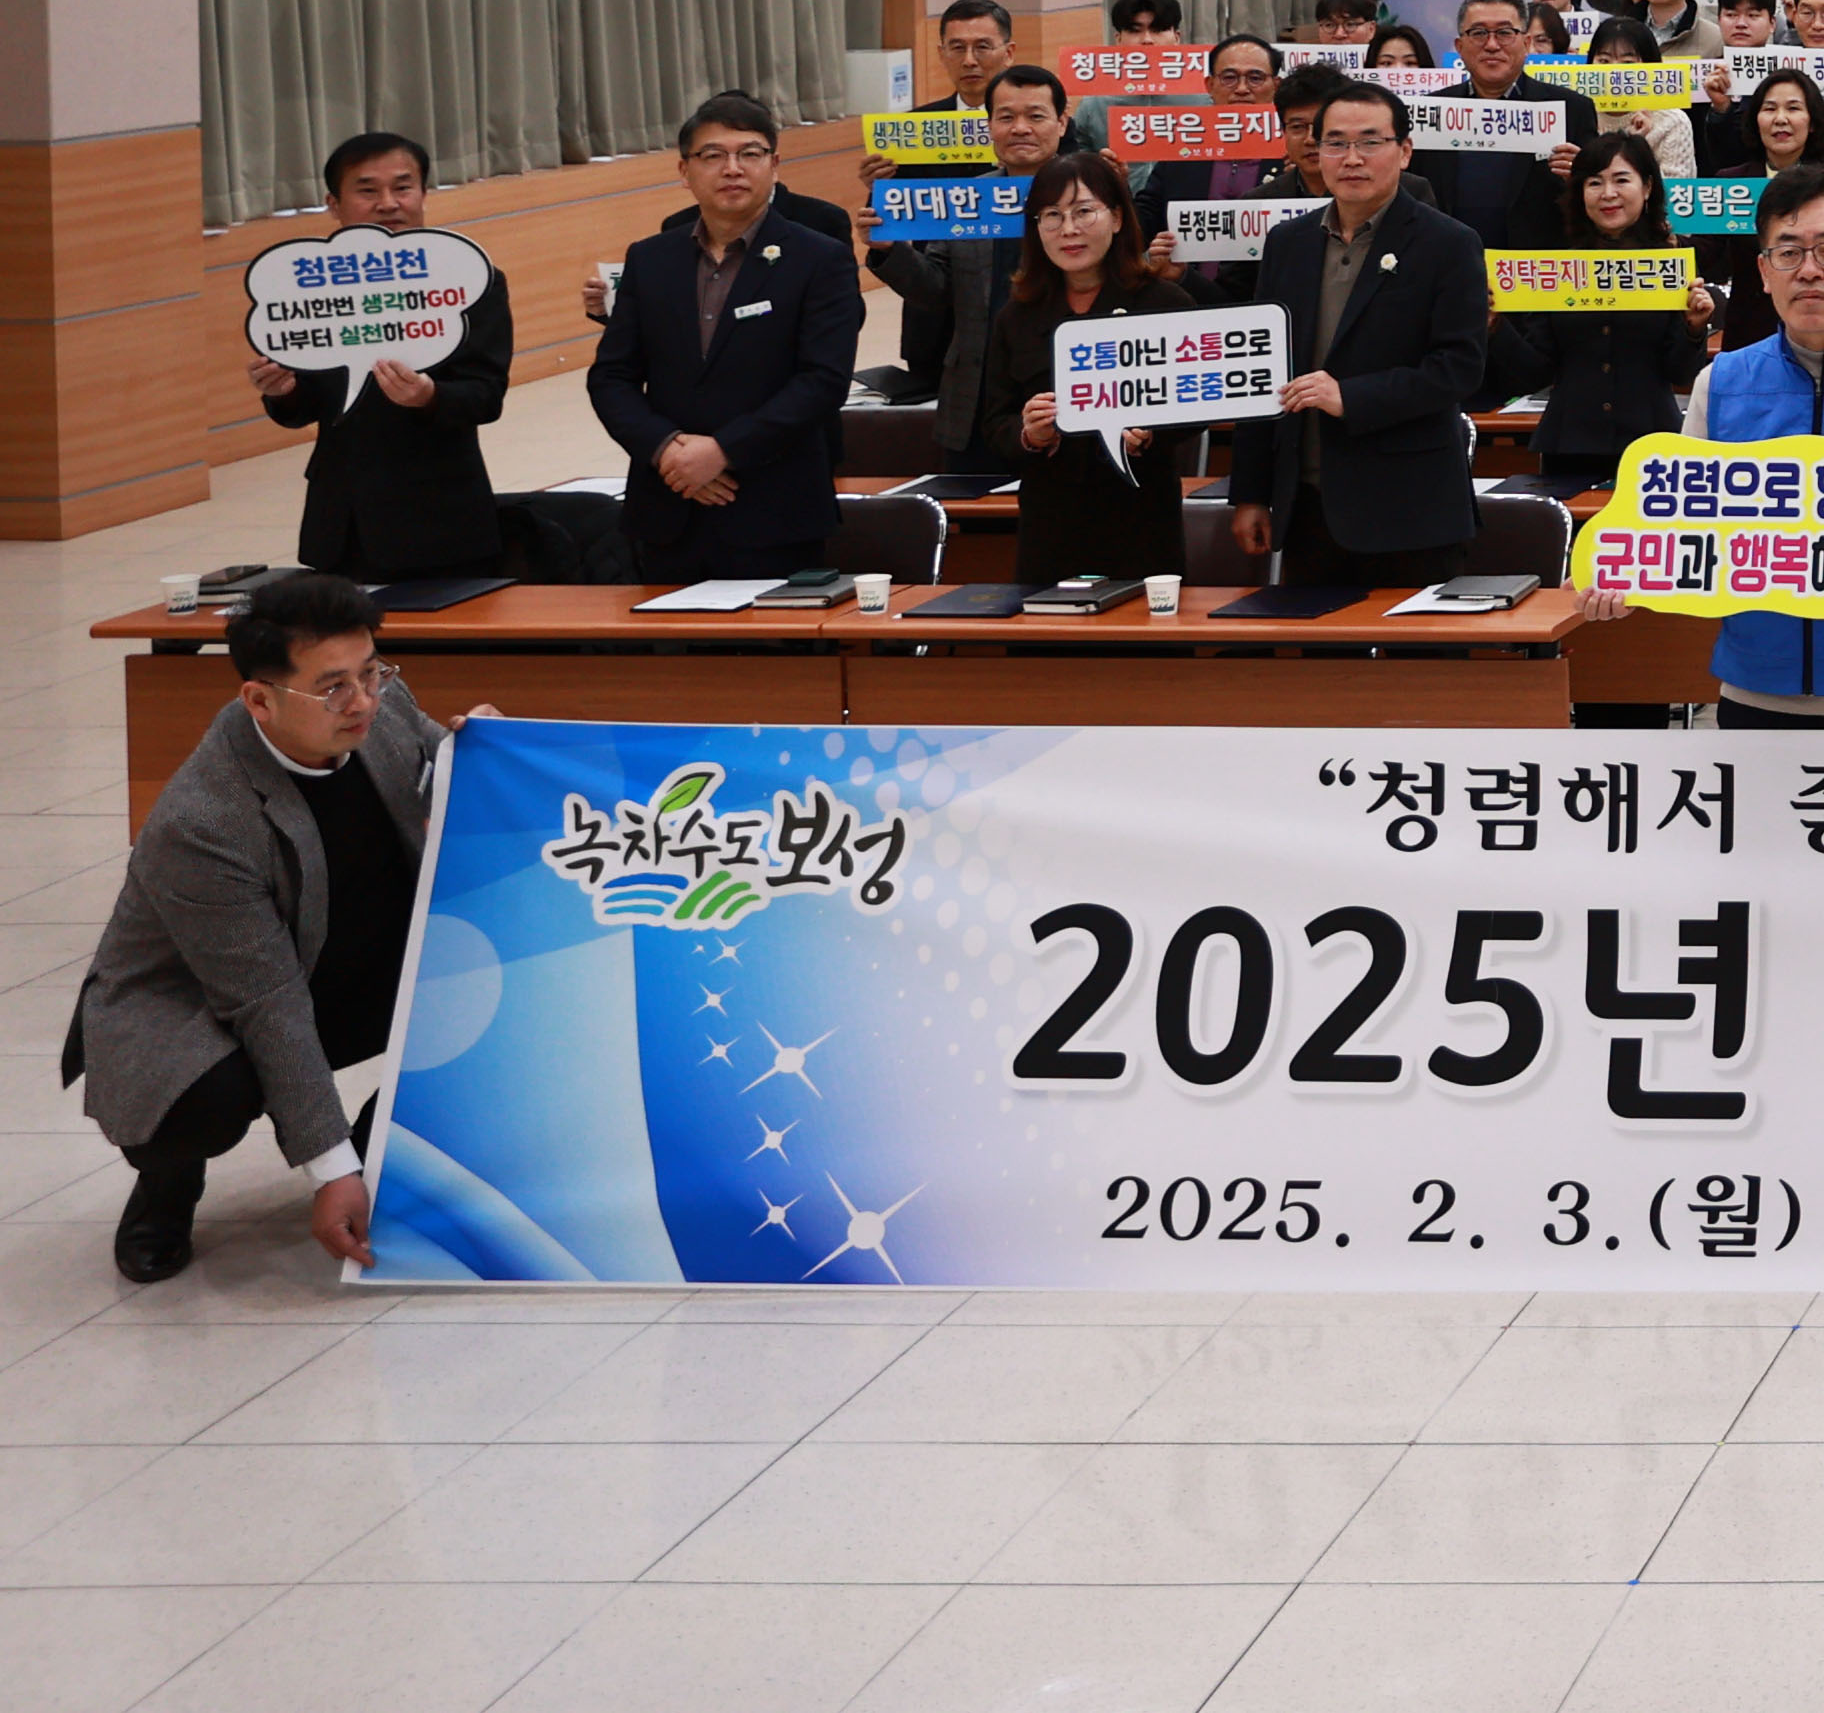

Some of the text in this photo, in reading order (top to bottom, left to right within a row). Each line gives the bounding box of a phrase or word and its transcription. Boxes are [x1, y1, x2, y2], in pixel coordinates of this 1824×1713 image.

[1070, 51, 1150, 81] 청탁은
[872, 118, 957, 151] 생각은 청렴!
[1119, 110, 1283, 145] 청탁은 금지!
[1446, 107, 1557, 135] OUT, 긍정사회 UP
[883, 184, 980, 221] 위대한
[1668, 183, 1754, 218] 청렴은
[291, 248, 430, 288] 청렴실천
[1494, 256, 1687, 293] 청탁금지! 갑질근절!
[266, 287, 467, 324] 다시한번 생각하GO!
[266, 319, 446, 352] 나부터 실천하GO!
[1069, 328, 1272, 372] 호통아닌 소통으로
[1069, 368, 1273, 411] 무시아닌 존중으로
[1640, 457, 1801, 519] 청렴으로
[1595, 532, 1718, 593] 군민과
[766, 790, 906, 906] 보성
[1011, 899, 1752, 1122] 2025년
[1099, 1174, 1352, 1249] 2025.
[1406, 1175, 1486, 1250] 2.
